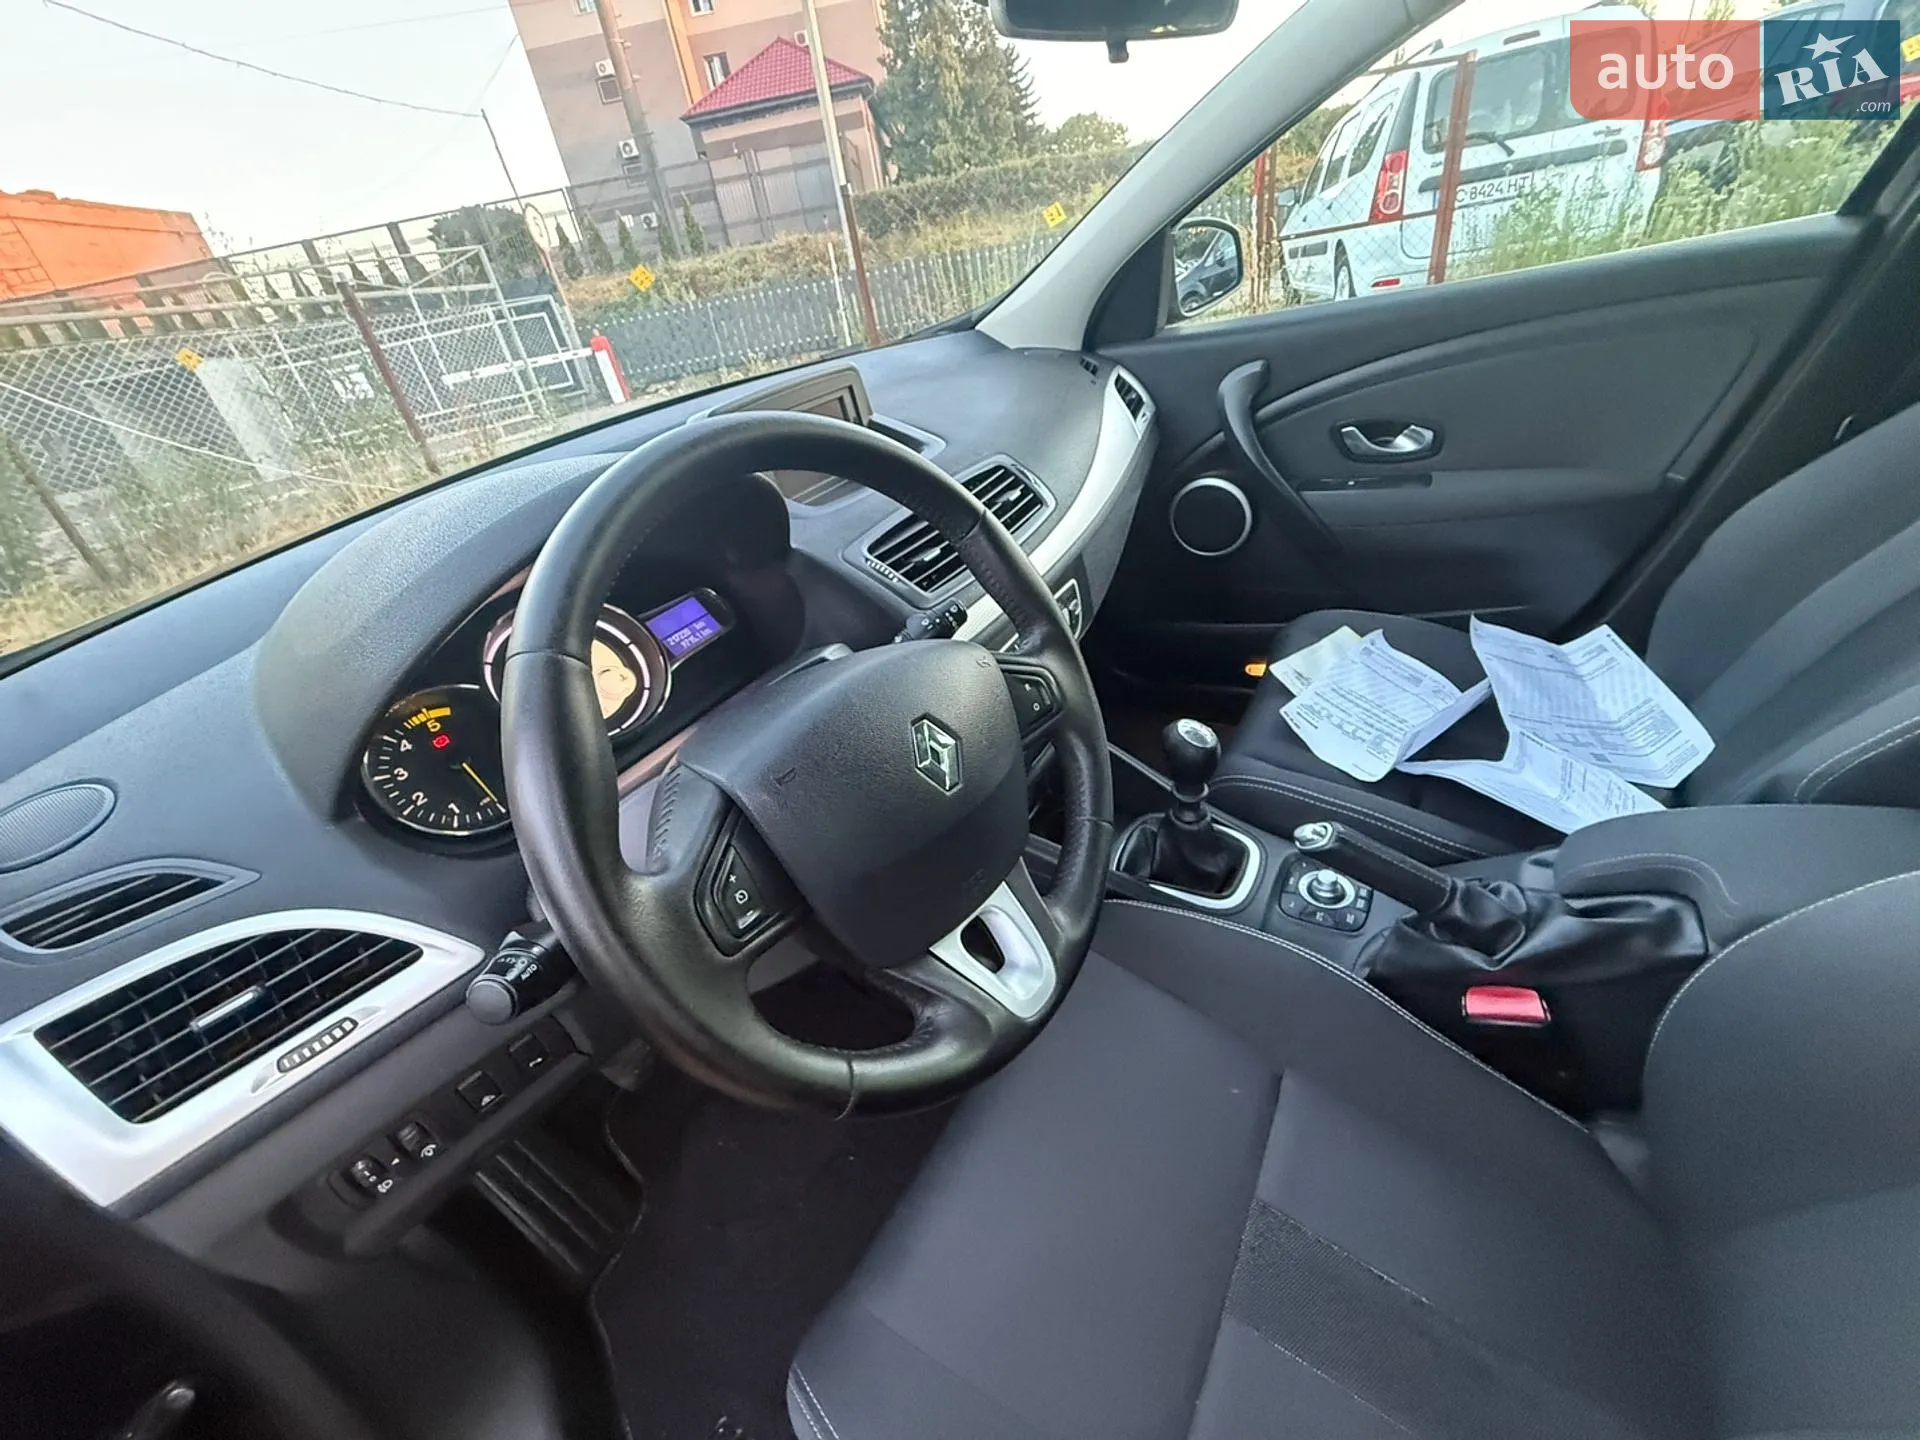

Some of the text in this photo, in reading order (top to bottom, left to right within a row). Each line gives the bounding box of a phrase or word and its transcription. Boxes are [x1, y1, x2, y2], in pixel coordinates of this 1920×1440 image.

[1469, 180, 1504, 200] 8424
[426, 719, 441, 732] 5
[400, 739, 412, 752] 4
[394, 768, 408, 780] 3
[412, 792, 428, 806] 2
[448, 803, 460, 814] 1
[520, 963, 538, 981] AUTO
